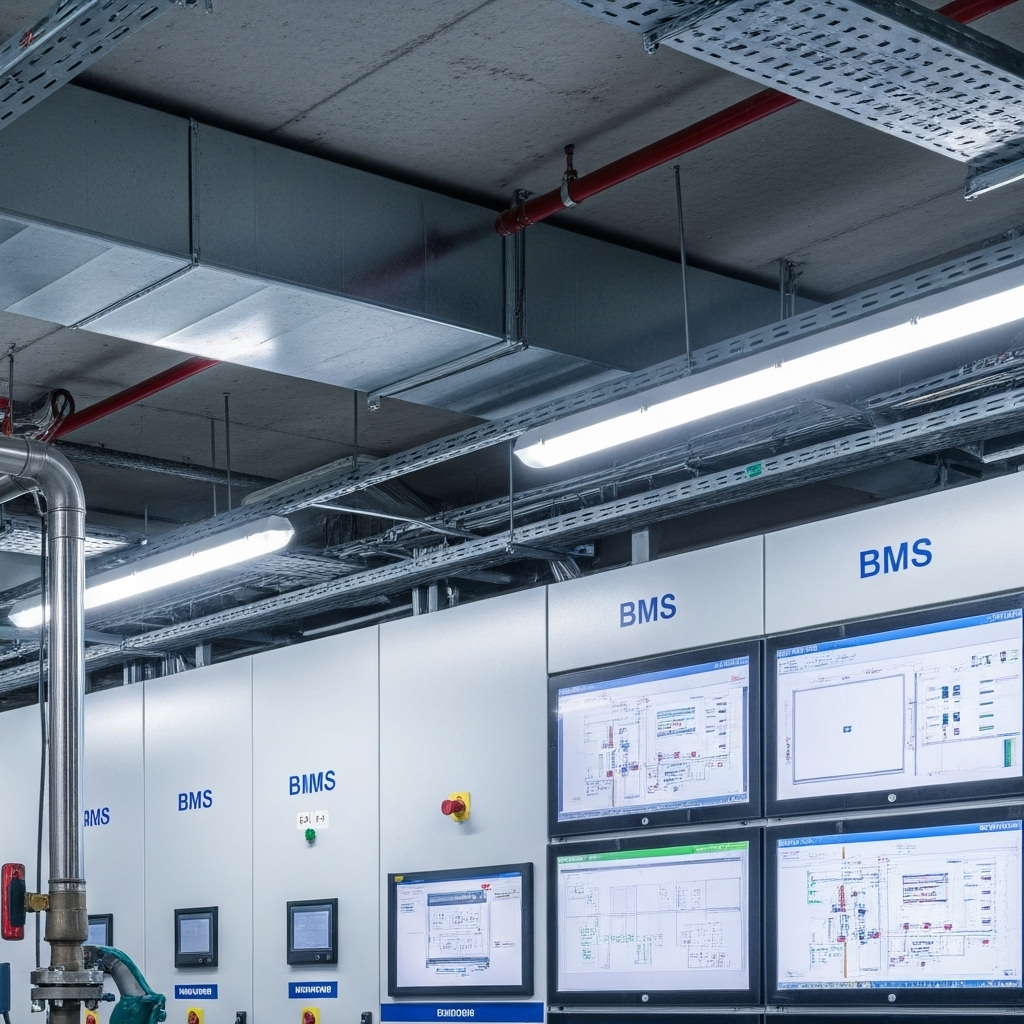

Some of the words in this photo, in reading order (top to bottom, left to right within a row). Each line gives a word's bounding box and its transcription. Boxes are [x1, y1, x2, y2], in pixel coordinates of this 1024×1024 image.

[859, 538, 933, 579] BMS
[619, 593, 677, 628] BMS
[178, 790, 213, 812] BMS
